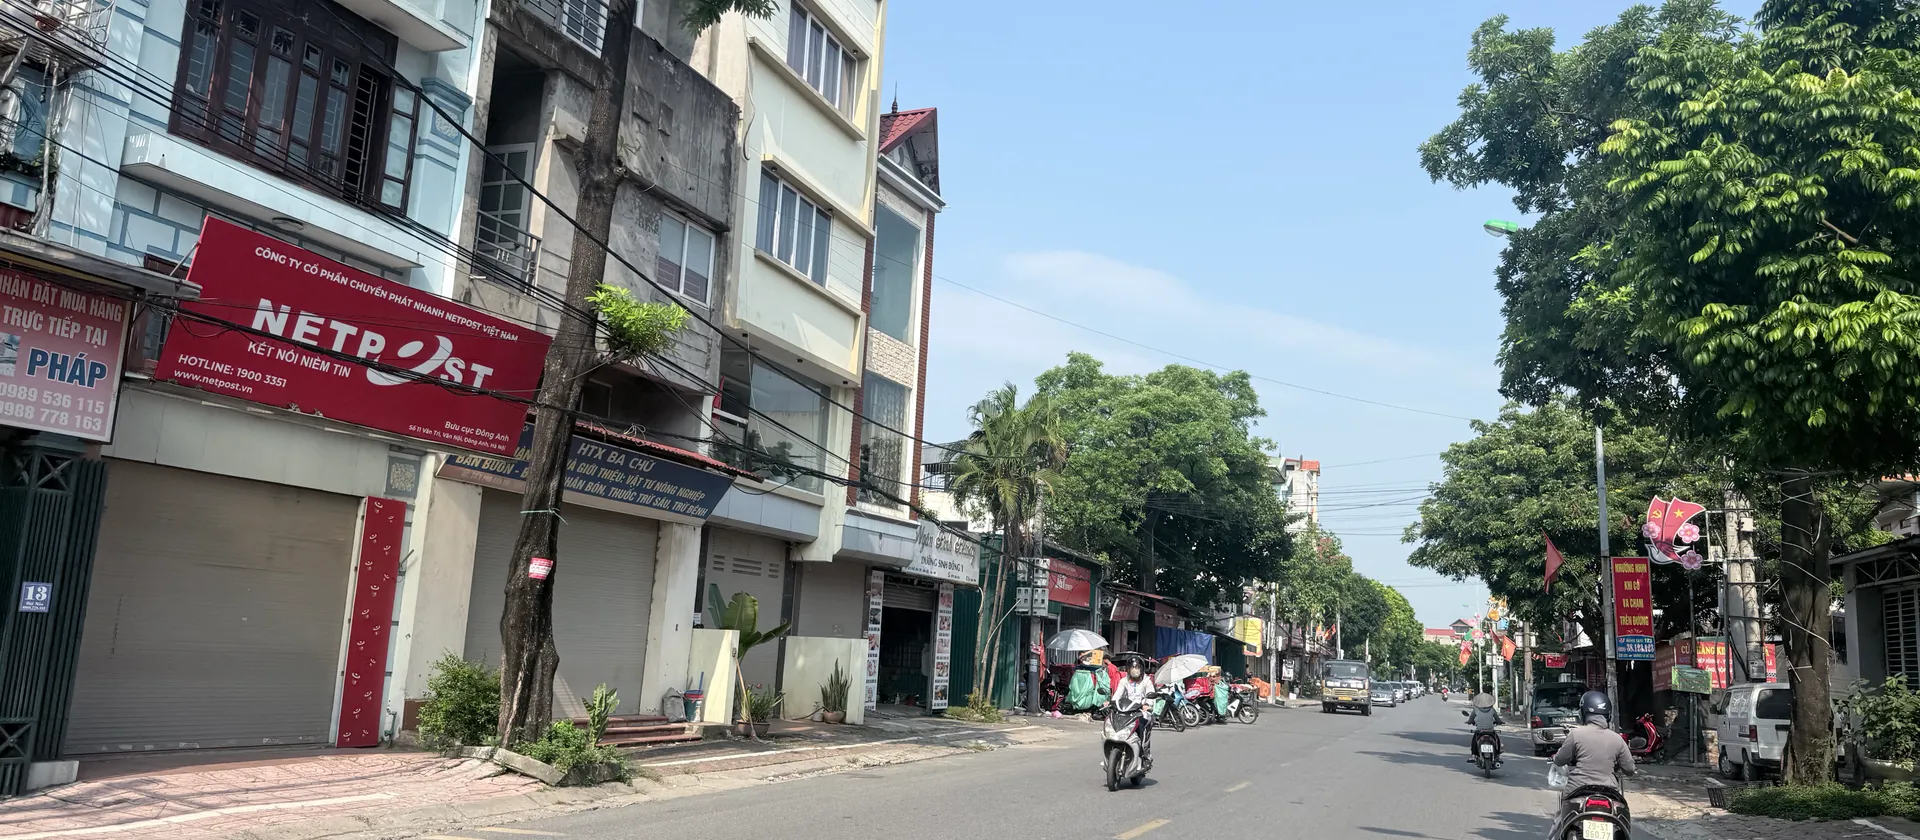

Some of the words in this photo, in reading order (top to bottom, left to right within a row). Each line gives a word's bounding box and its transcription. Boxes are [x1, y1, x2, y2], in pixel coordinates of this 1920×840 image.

[32, 281, 59, 308] ĐẶT
[59, 289, 87, 314] MUA
[89, 296, 123, 323] HÀNG
[255, 246, 287, 265] CÔNG
[288, 257, 303, 270] TY
[303, 262, 320, 275] CỔ
[320, 269, 348, 286] PHẦN
[349, 279, 388, 299] CHUYỂN
[388, 292, 413, 307] PHÁT
[413, 300, 445, 319] NHANH
[445, 313, 482, 331] NETPOST
[482, 324, 500, 338] VIỆT
[499, 331, 519, 342] NAM
[3, 304, 44, 333] TRỰC
[48, 315, 81, 340] TIẾP
[85, 325, 109, 349] TẠI
[249, 297, 494, 390] NETPOST
[26, 346, 109, 389] PHÁP
[178, 353, 234, 375] HOTLINE:
[236, 367, 262, 383] 1900
[263, 374, 287, 388] 3351
[332, 363, 352, 378] TIN
[174, 368, 253, 394] www.netpost.vn
[42, 390, 72, 409] 536
[77, 396, 105, 415] 115
[39, 407, 70, 426] 778
[74, 414, 102, 432] 163
[444, 420, 461, 431] Bưu
[461, 426, 475, 435] cục
[475, 428, 495, 441] Đông
[495, 432, 510, 442] Anh
[576, 442, 604, 459] HTX
[606, 450, 625, 467] BA
[577, 459, 599, 476] GIỚI
[599, 466, 626, 486] THIỆU:
[625, 472, 643, 490] VẬT
[643, 478, 658, 491] TƯ
[653, 481, 679, 496] NÔNG
[676, 486, 706, 503] NGHIỆP
[584, 480, 606, 496] BÓN,
[608, 483, 636, 502] THUỐC
[636, 493, 656, 505] TRỪ
[653, 496, 672, 510] SÂU,
[672, 500, 690, 513] TRỪ
[686, 504, 708, 518] BỆNH
[25, 586, 47, 601] 13
[1623, 580, 1633, 591] KHI
[1622, 598, 1630, 608] VA
[1629, 598, 1644, 610] CHẠM
[1619, 614, 1633, 626] TRÊN
